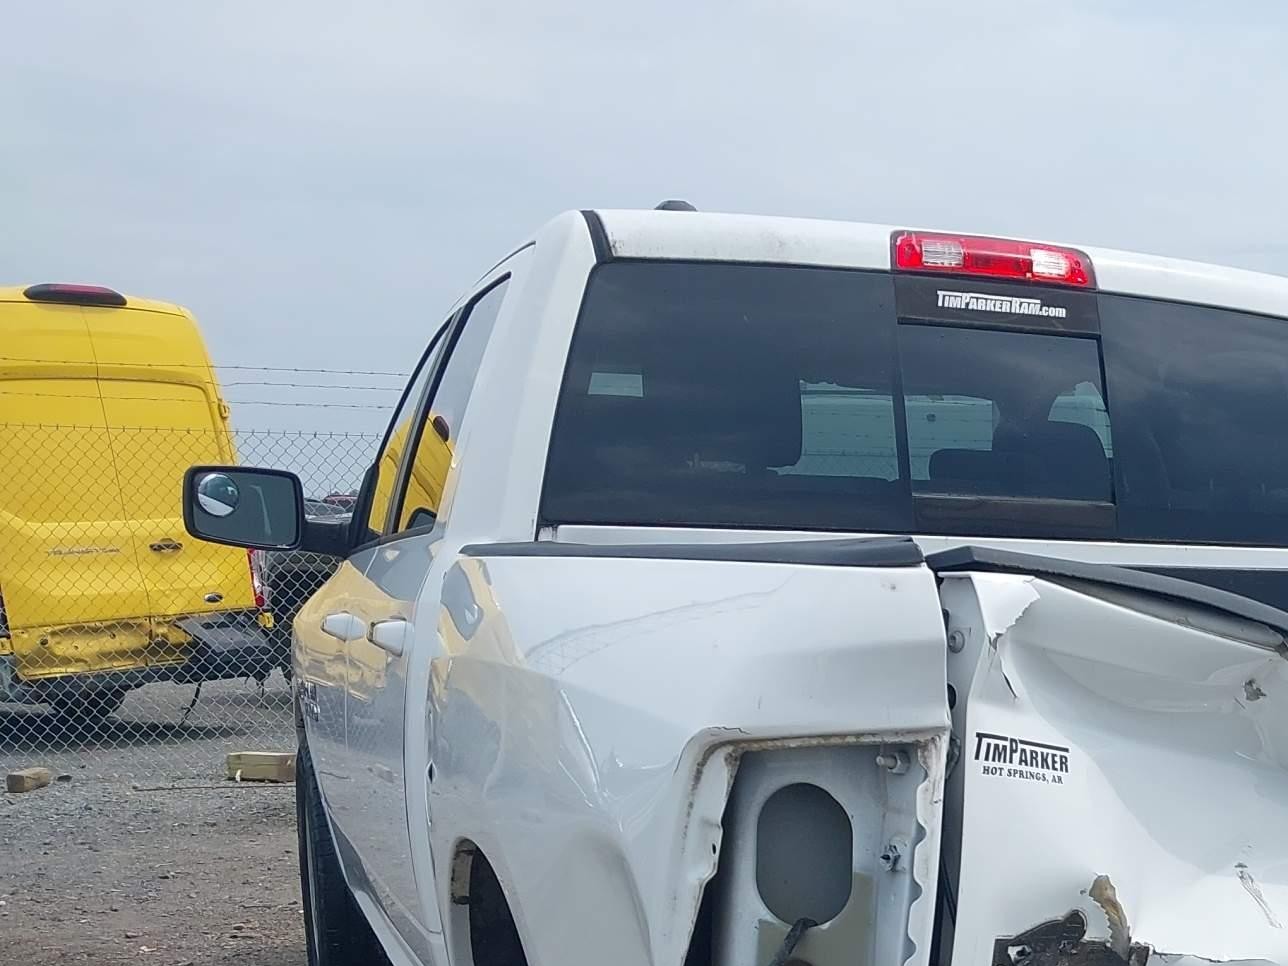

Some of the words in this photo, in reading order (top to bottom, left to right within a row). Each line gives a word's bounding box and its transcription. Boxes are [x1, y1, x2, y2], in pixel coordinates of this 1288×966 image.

[982, 765, 1004, 776] HOT
[1006, 768, 1049, 784] SPRINGS,
[1051, 775, 1064, 784] AR
